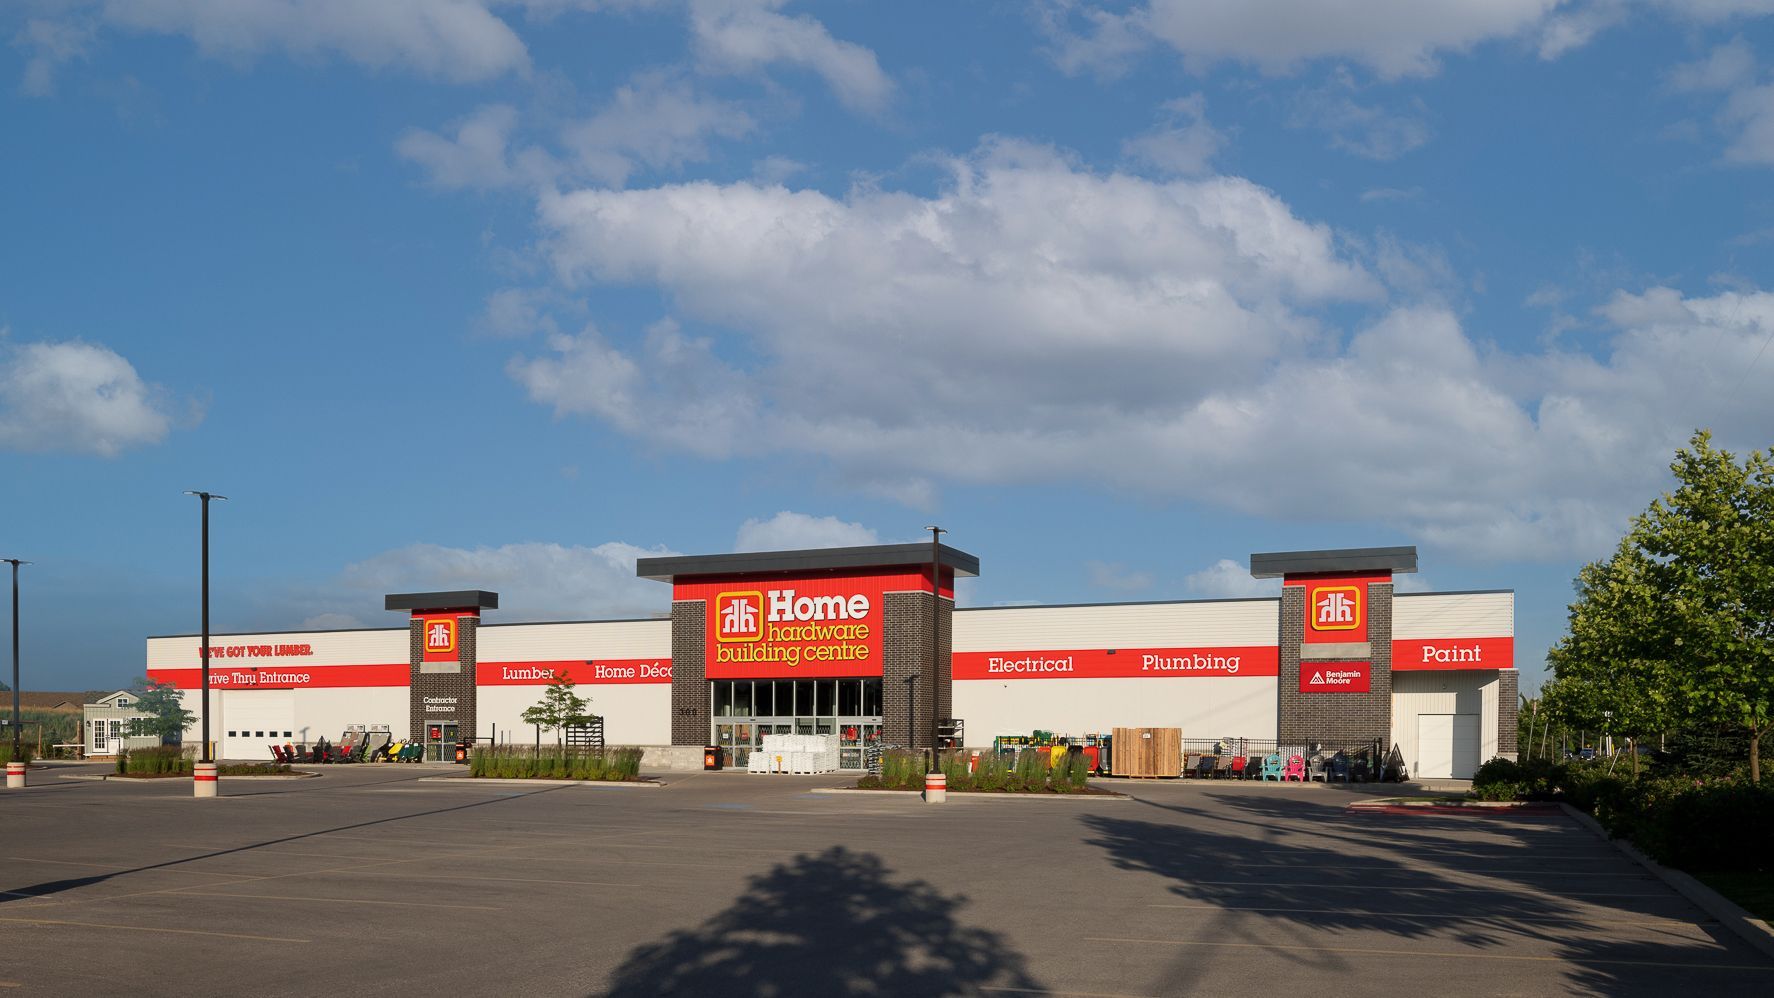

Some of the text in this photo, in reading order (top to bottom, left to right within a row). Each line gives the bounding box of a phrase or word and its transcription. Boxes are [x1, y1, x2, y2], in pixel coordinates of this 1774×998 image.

[768, 589, 870, 622] Home
[768, 622, 869, 642] hardware
[226, 646, 245, 657] GOT
[247, 645, 272, 657] YOUR
[274, 644, 313, 656] LUMBER.
[716, 641, 869, 667] building centre
[1422, 645, 1482, 663] Paint
[502, 662, 673, 680] Lumber Home Déco
[988, 657, 1073, 673] Electrical
[1142, 654, 1240, 673] Plumbing
[208, 672, 310, 685] rive Thru Entrance
[1326, 670, 1361, 679] Benjamin
[423, 696, 457, 704] Contractor
